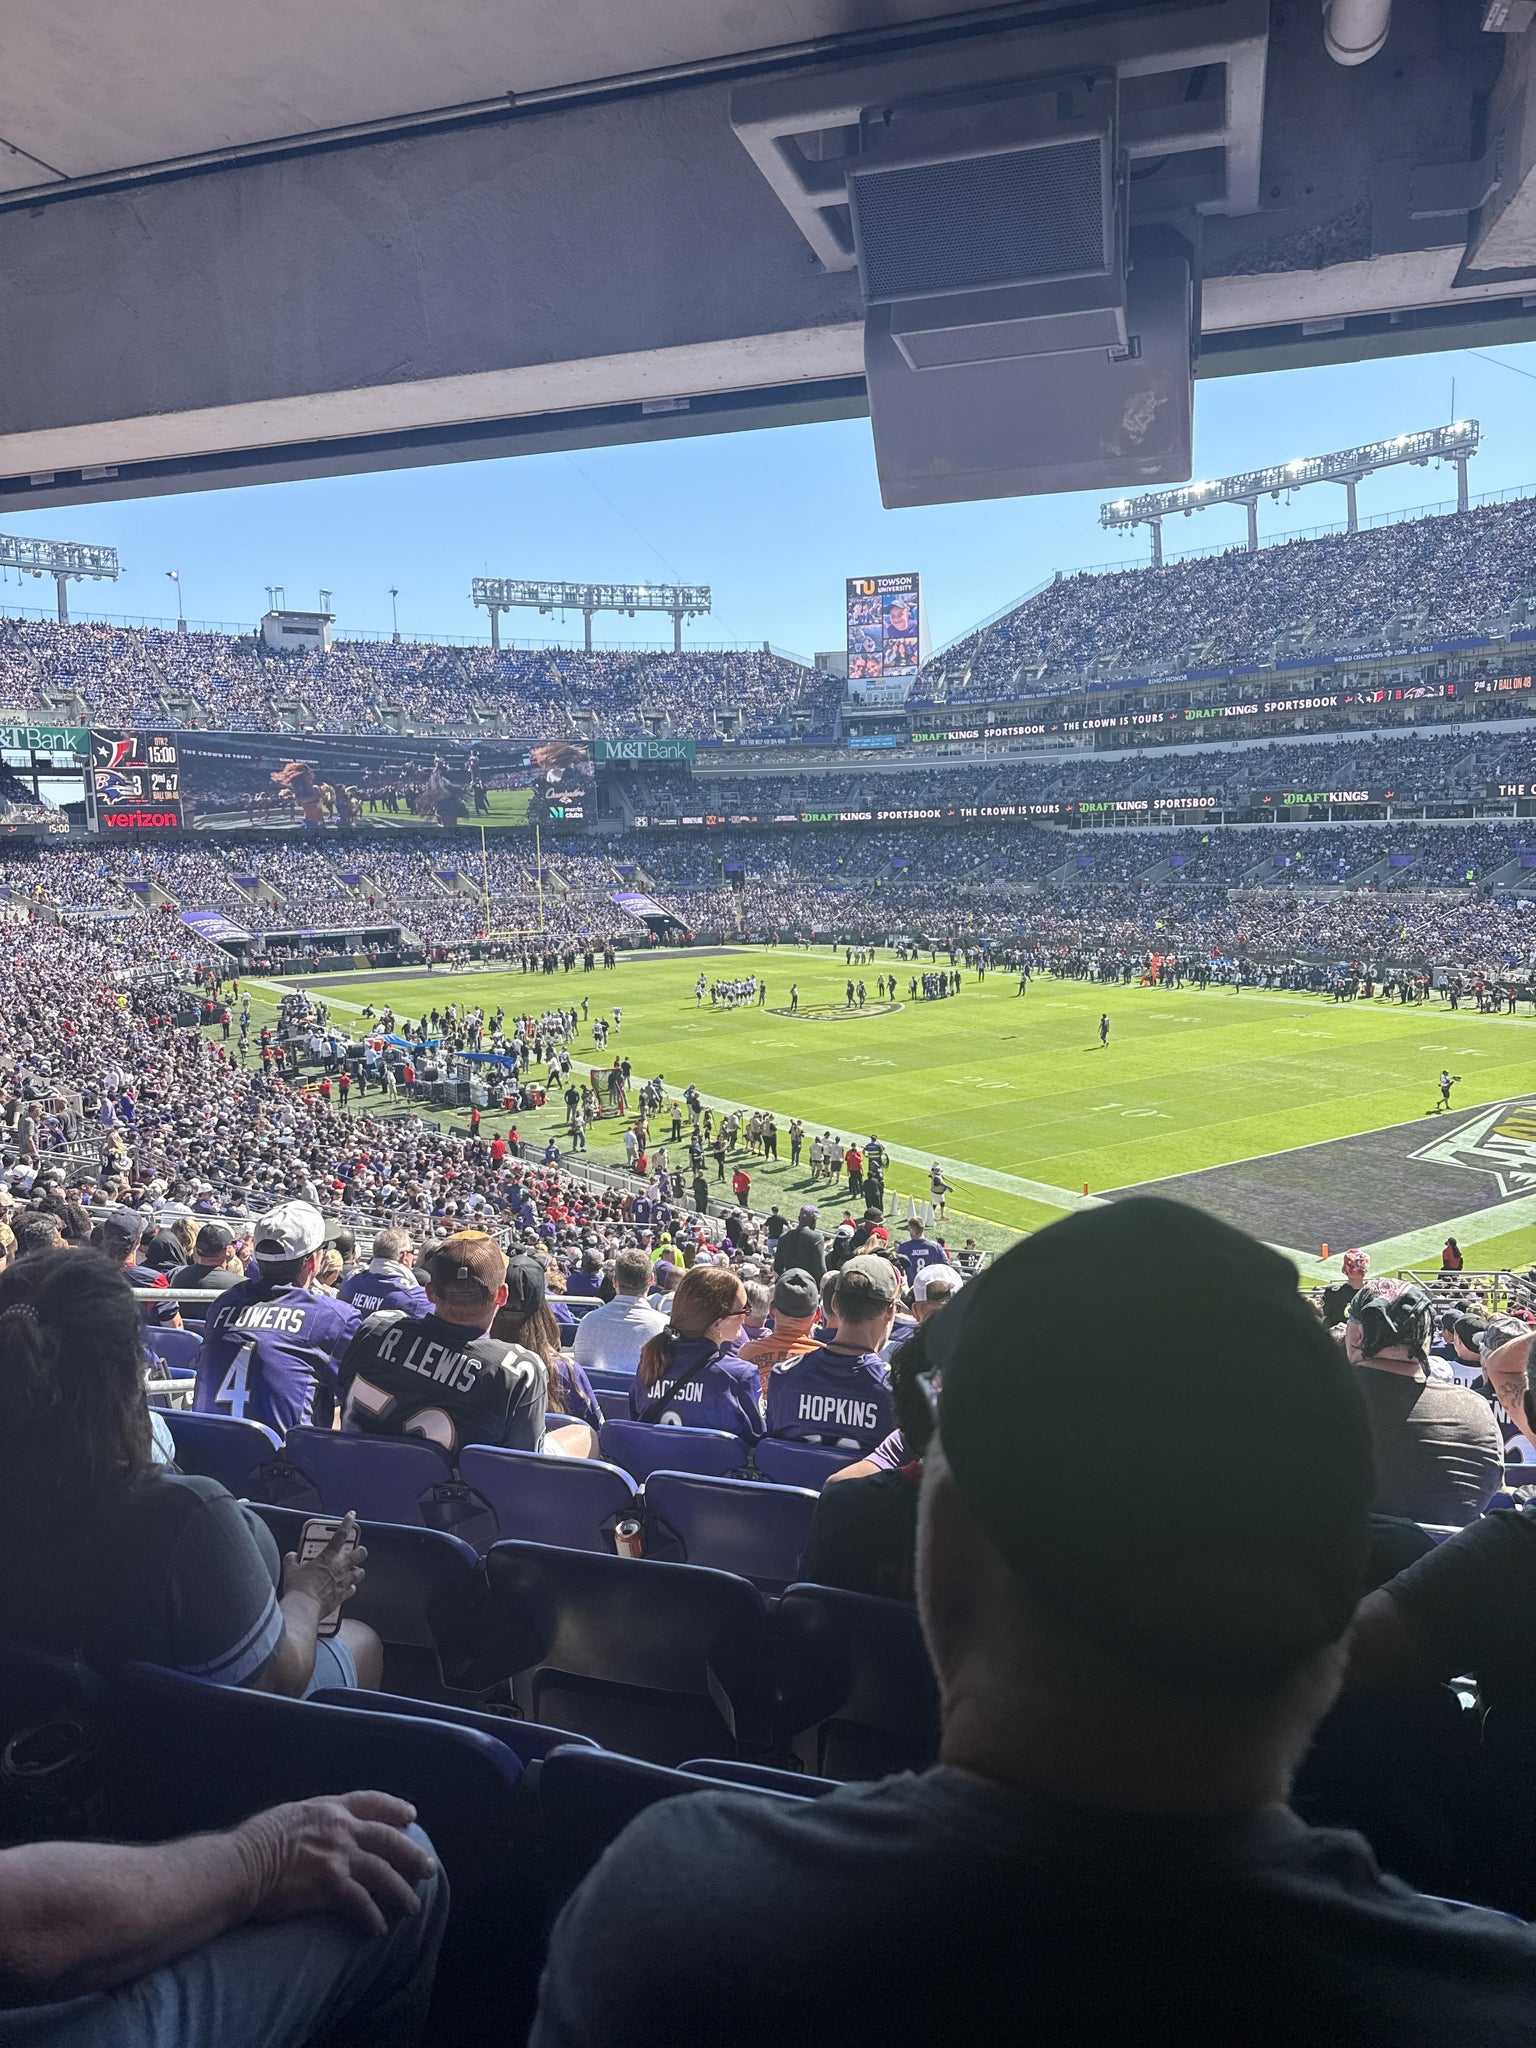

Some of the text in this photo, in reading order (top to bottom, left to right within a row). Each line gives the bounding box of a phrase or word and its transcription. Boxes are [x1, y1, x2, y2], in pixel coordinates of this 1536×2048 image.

[877, 577, 912, 587] TOWSON
[877, 585, 912, 593] UNIVERSITY
[1353, 652, 1383, 661] CHAMPIONS
[1184, 696, 1338, 721] DRAFTKINGS SPORTSBOOK
[1063, 713, 1164, 731] THE CROWN IS YOURS
[26, 728, 78, 750] Bank
[912, 724, 1045, 743] DRAFTKINGS SPORTSBOOK
[130, 737, 137, 758] 7
[148, 746, 176, 763] 15:00
[604, 741, 687, 759] M&T Bank
[133, 775, 142, 795] 3
[1498, 784, 1525, 796] THE
[1079, 797, 1217, 813] DRAFTKINGS SPORTSBOO
[1283, 790, 1369, 804] DRAFTKINGS
[103, 809, 177, 827] verizon
[801, 812, 872, 823] DRAFTKINGS
[877, 809, 941, 820] SPORTSBOOK
[960, 804, 1060, 817] THE CROWN IS YOURS
[351, 1292, 385, 1311] HENRY
[213, 1306, 306, 1333] FLOWERS
[377, 1328, 483, 1393] R. LEWIS
[214, 1341, 257, 1418] 4
[647, 1380, 704, 1403] JACSON
[799, 1393, 878, 1429] HOPKINS
